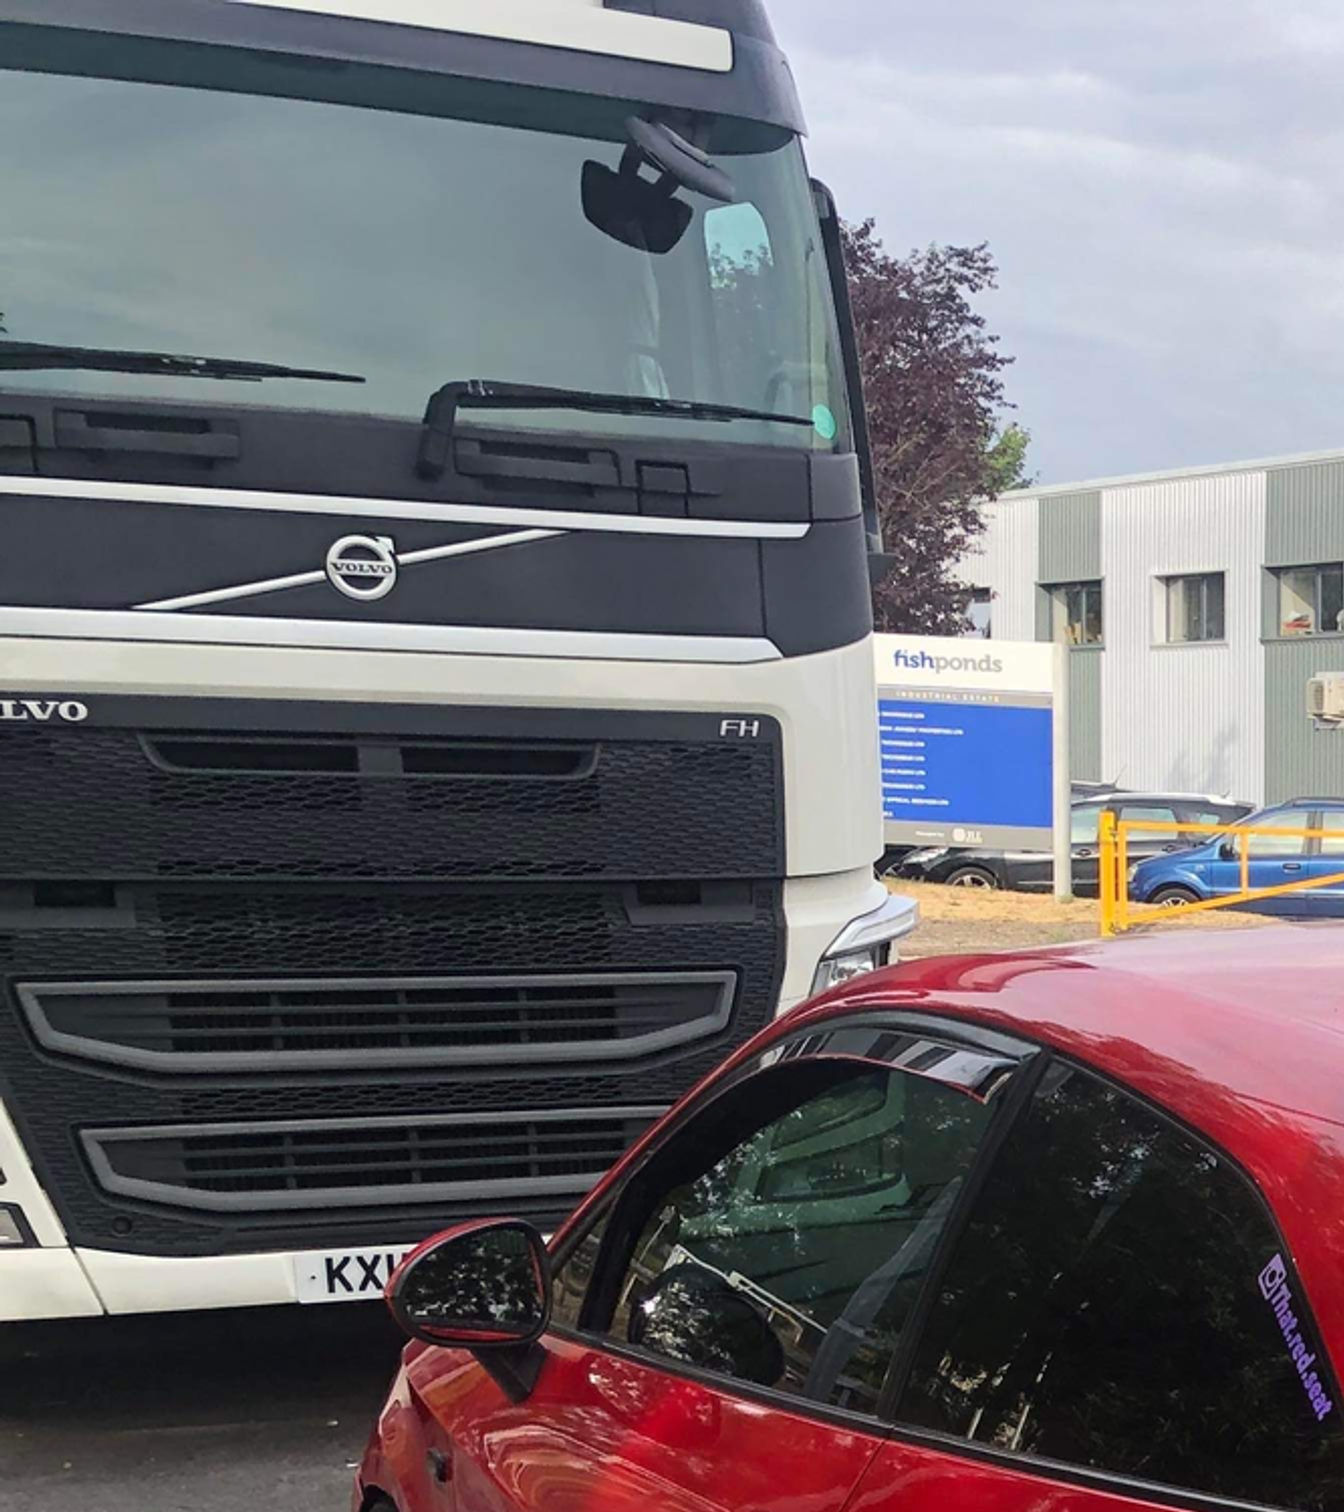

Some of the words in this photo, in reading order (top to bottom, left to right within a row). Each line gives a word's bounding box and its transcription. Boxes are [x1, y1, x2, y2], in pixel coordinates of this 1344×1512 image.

[331, 562, 393, 574] VOLVO
[893, 649, 1003, 674] fishponds
[720, 719, 760, 737] FH
